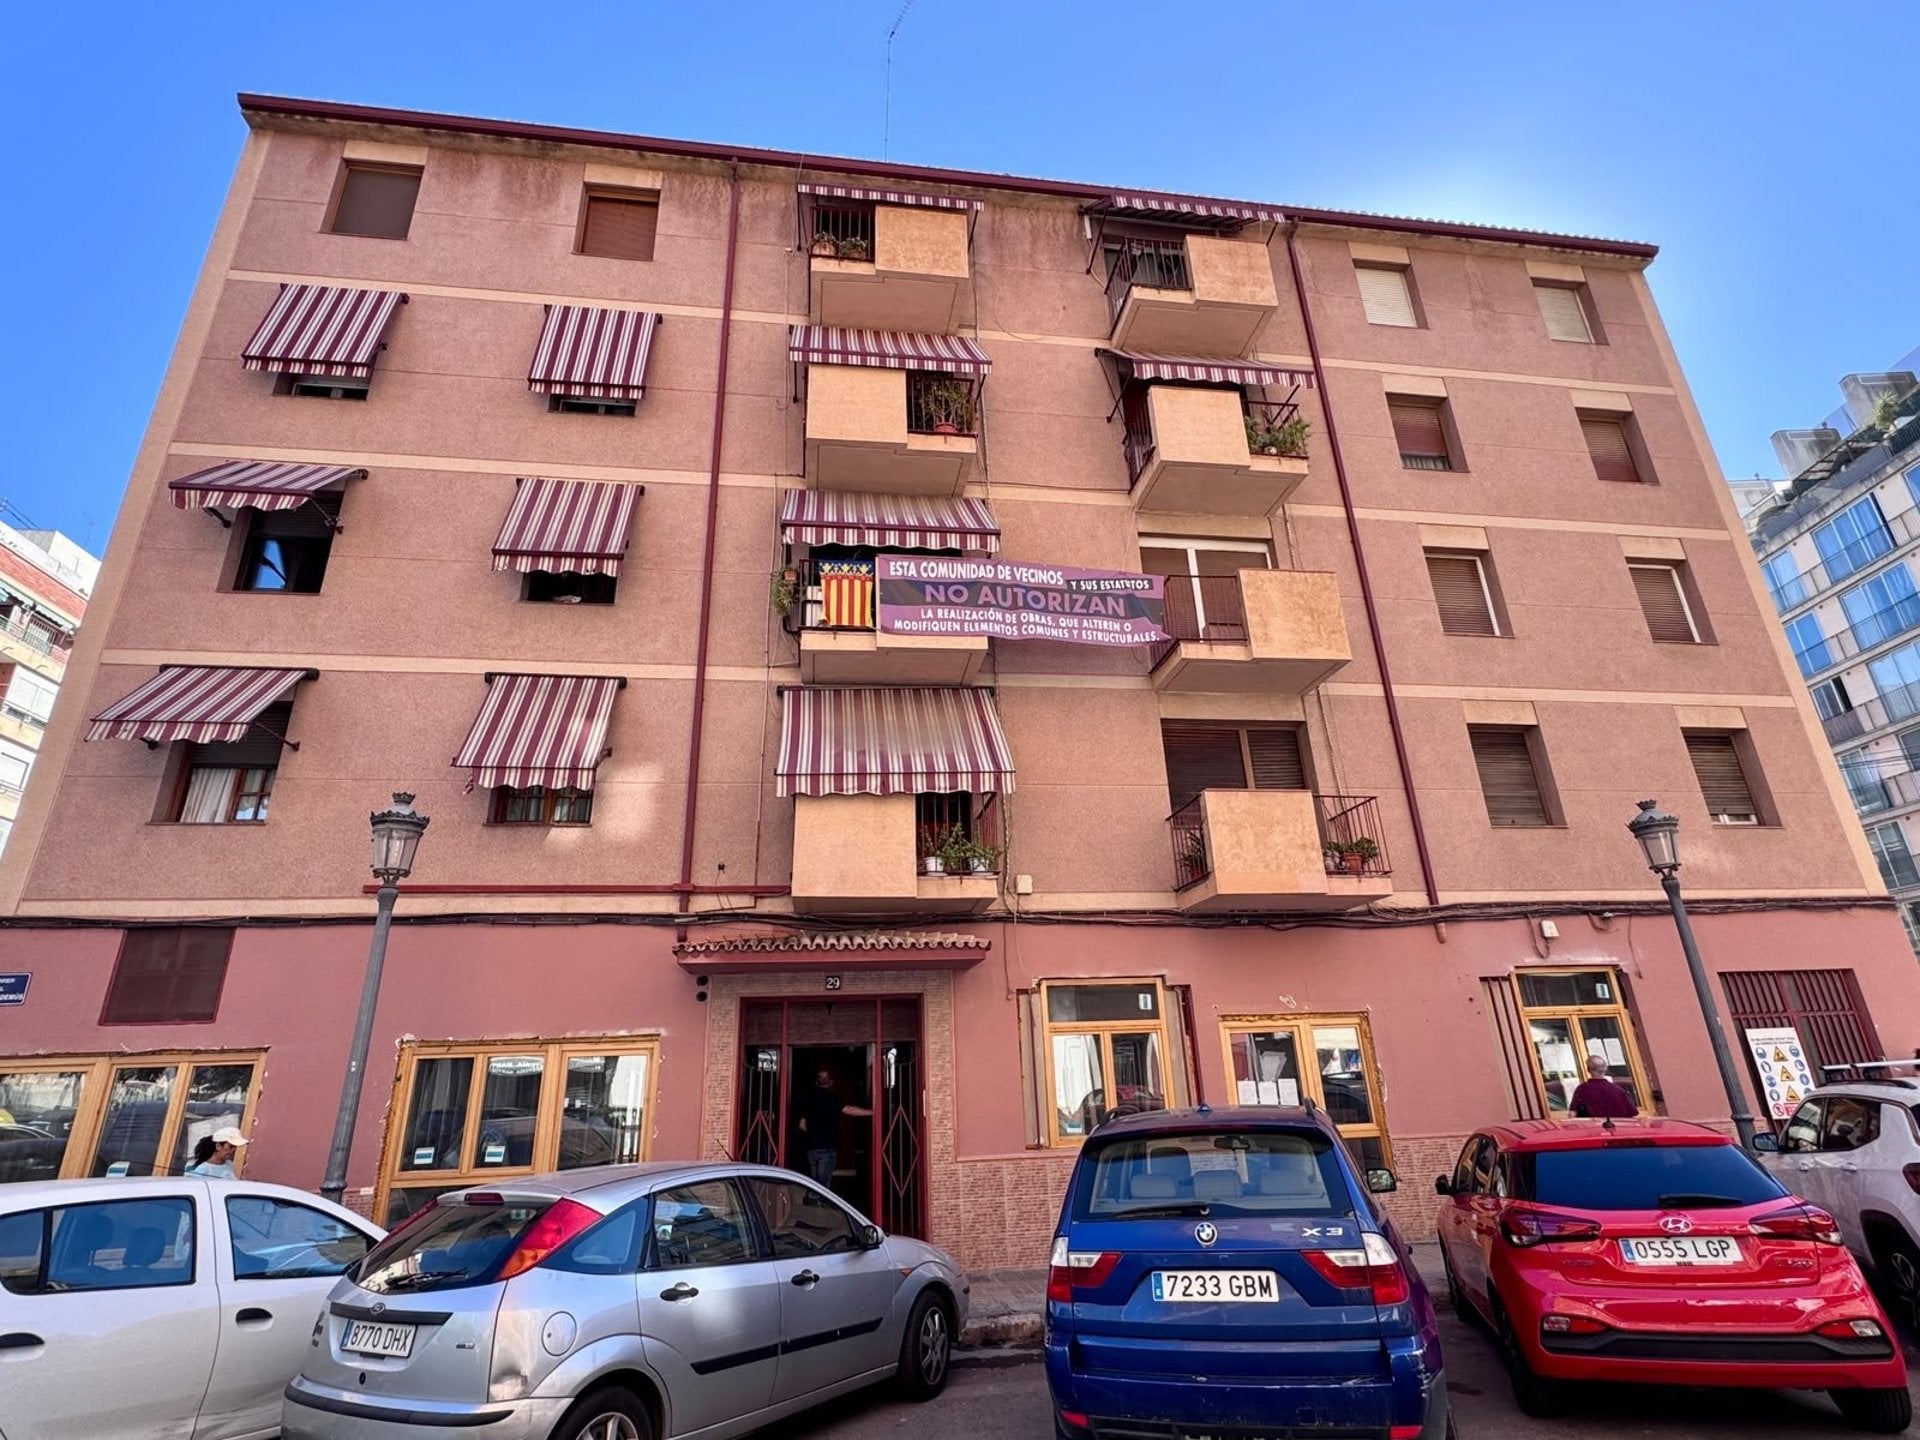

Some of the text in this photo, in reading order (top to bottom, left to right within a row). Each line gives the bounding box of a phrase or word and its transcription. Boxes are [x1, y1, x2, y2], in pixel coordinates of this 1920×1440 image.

[890, 562, 1064, 586] ESTA COMUNIDAD DE VECINOS
[1070, 580, 1077, 590] Y
[1080, 580, 1097, 590] SUS
[924, 584, 1126, 617] NO AUTORIZAN
[894, 619, 1160, 644] MODIFIQUEN ELEMENTOS COMUNES Y ESTRUCTURALES.
[920, 608, 1132, 632] LA REALIZACIÓN DE OBRAS, QUE ALTEREN O
[826, 977, 840, 989] 29
[1302, 1226, 1344, 1237] X3
[1634, 1239, 1731, 1259] 0555 LGP
[1166, 1275, 1273, 1297] 7233 GBM
[350, 1324, 382, 1348] 8770
[382, 1328, 412, 1352] DHX
